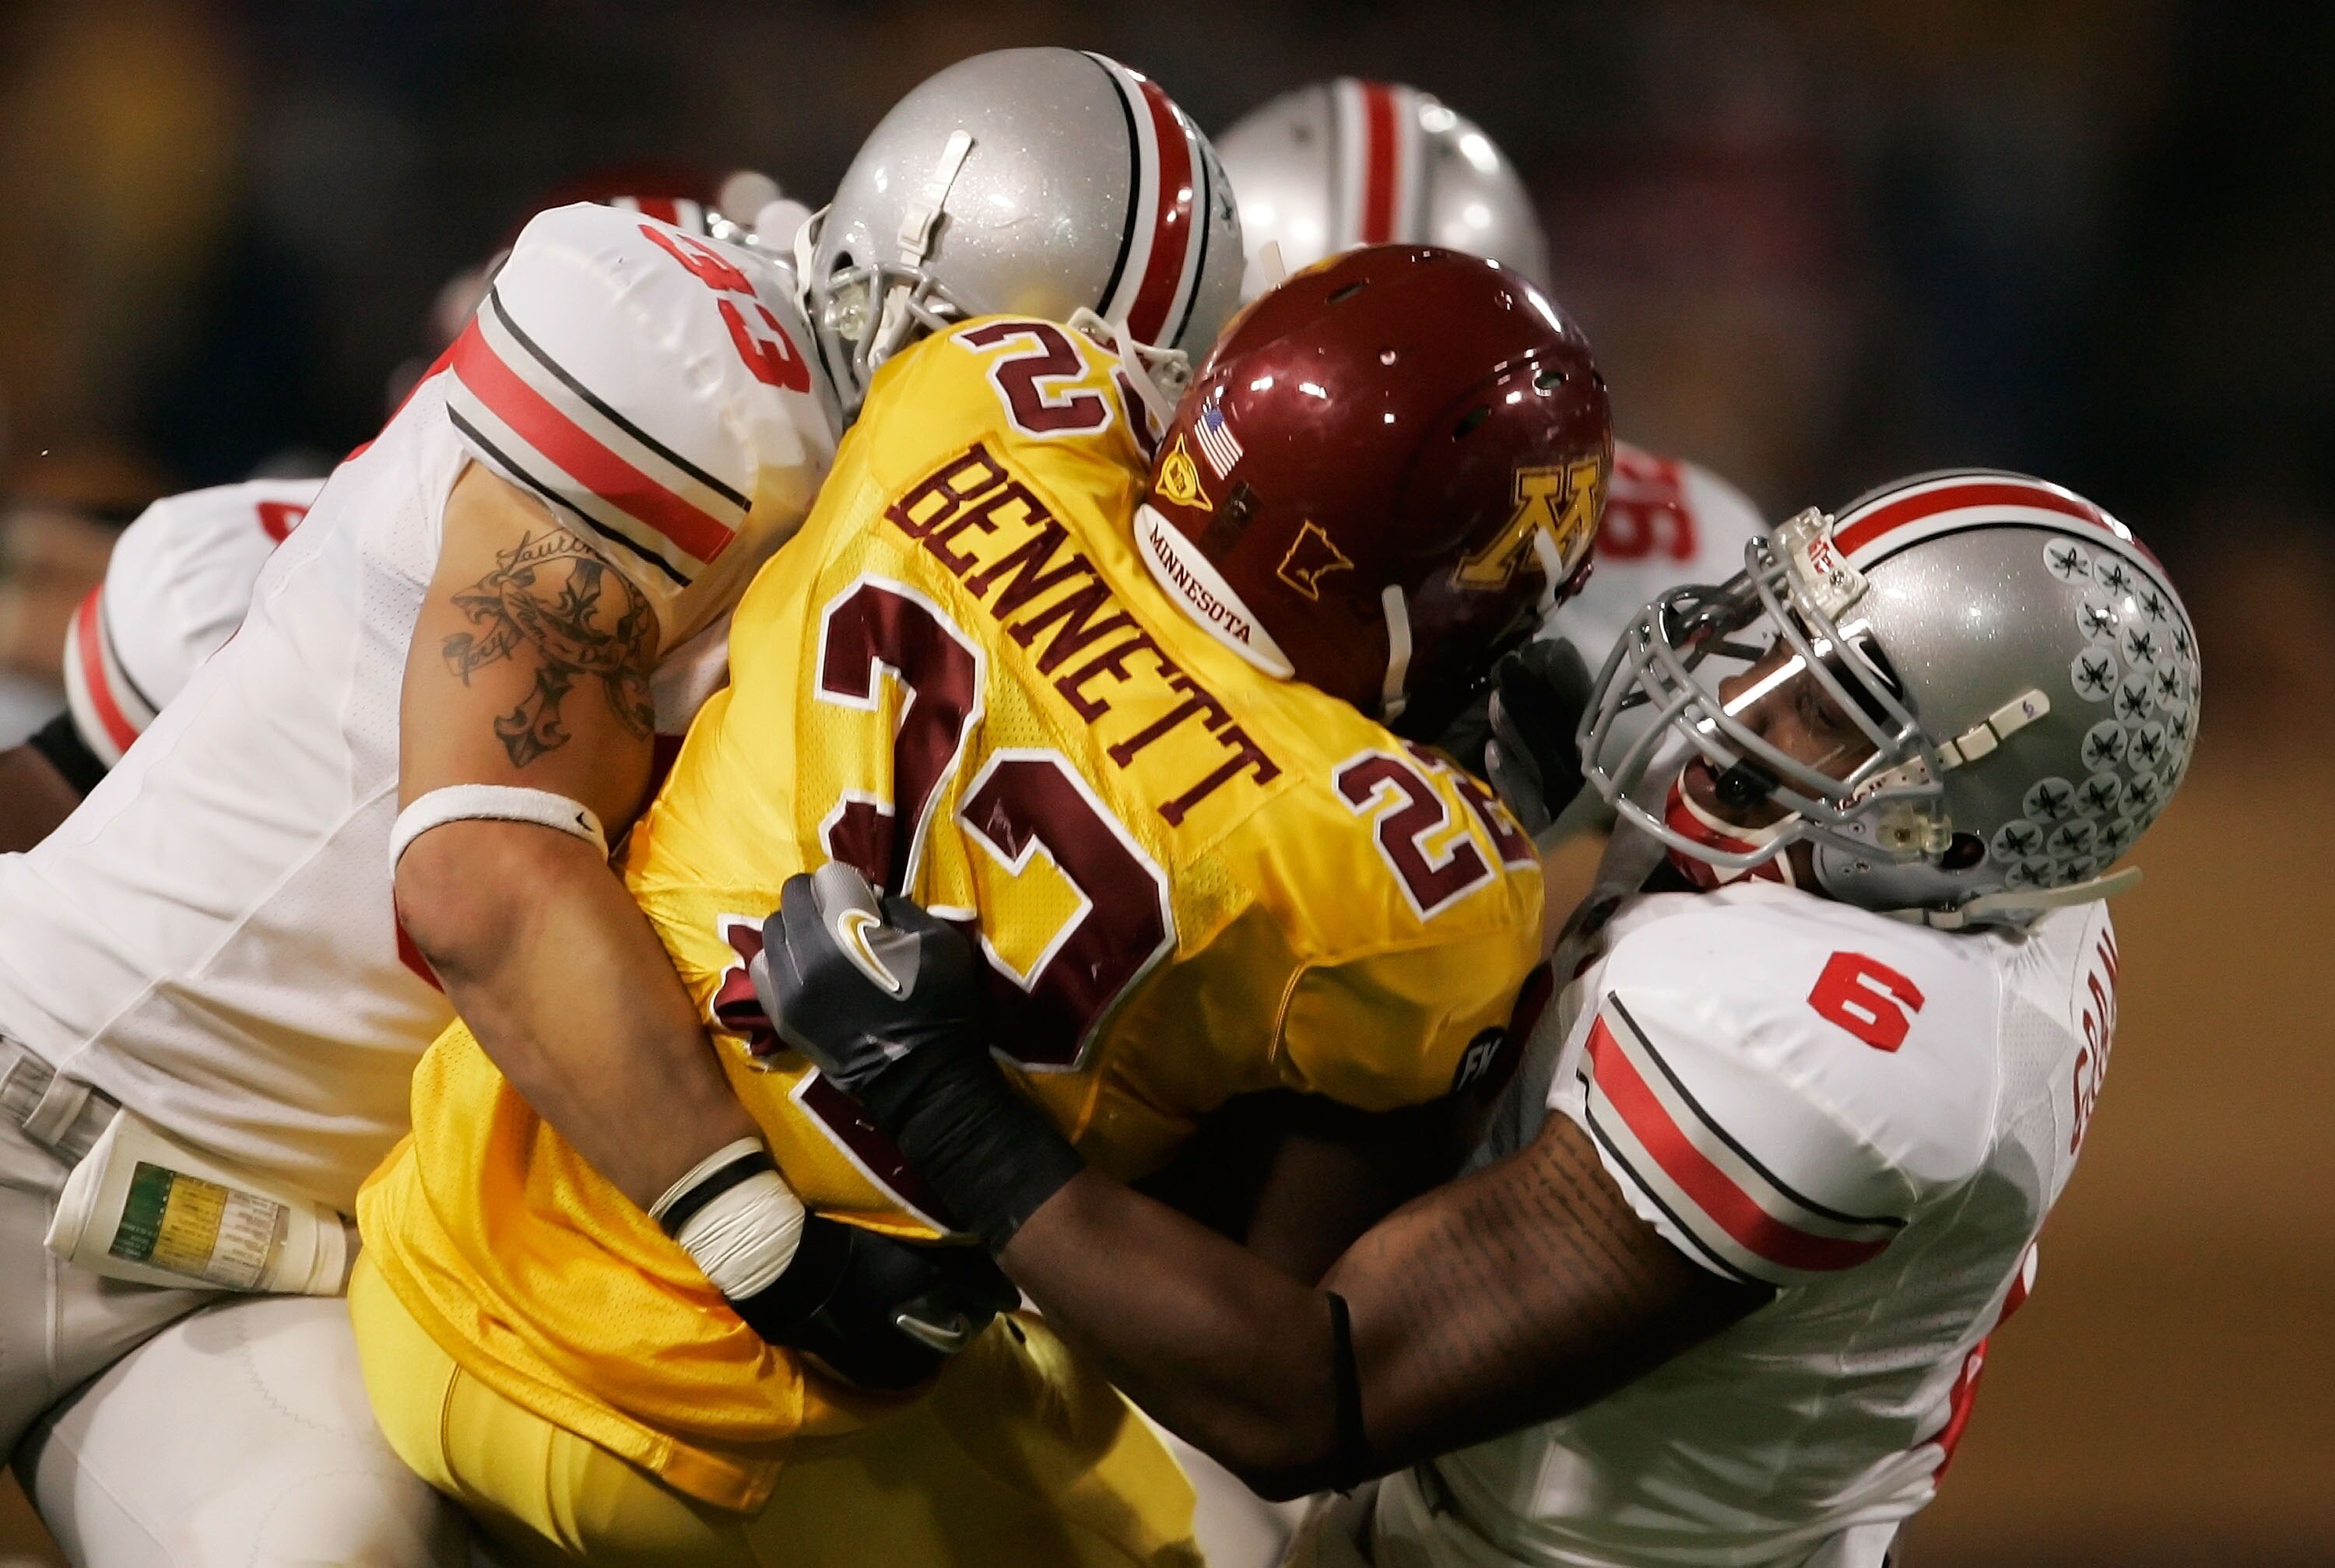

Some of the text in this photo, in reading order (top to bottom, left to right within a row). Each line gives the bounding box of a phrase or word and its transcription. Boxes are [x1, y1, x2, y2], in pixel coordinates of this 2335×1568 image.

[637, 224, 810, 395] 33
[884, 442, 1283, 830] BENNETT
[1149, 522, 1253, 645] MINNESOTA
[1807, 950, 1926, 1053] 6
